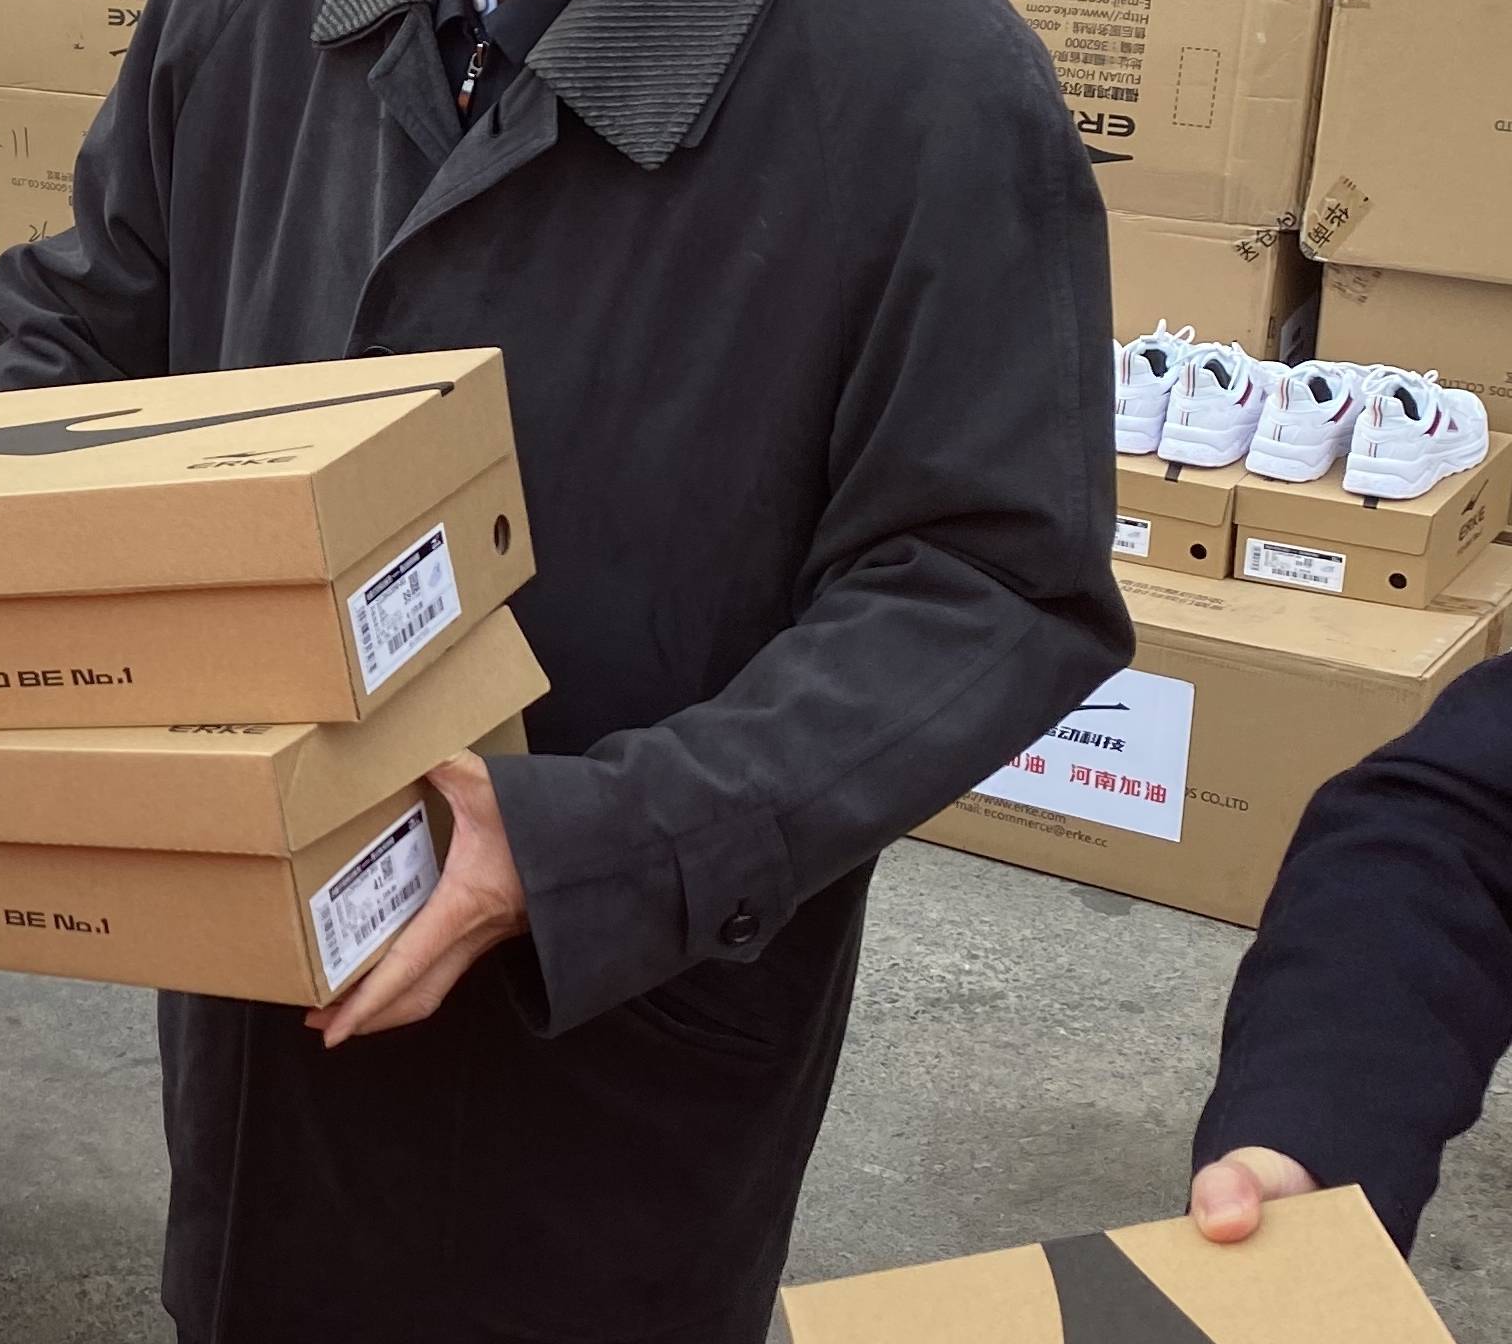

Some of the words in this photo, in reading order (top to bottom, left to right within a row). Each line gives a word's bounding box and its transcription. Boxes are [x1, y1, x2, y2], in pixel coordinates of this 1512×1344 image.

[107, 8, 143, 27] KE
[1055, 66, 1096, 80] HONG
[1098, 70, 1141, 85] FUJIAN
[1069, 109, 1136, 138] ER
[186, 455, 298, 470] ERKE
[17, 670, 64, 687] BE
[71, 667, 133, 686] No.1
[1069, 764, 1168, 805] 河南加油
[4, 909, 46, 928] BE
[53, 913, 110, 935] No.1
